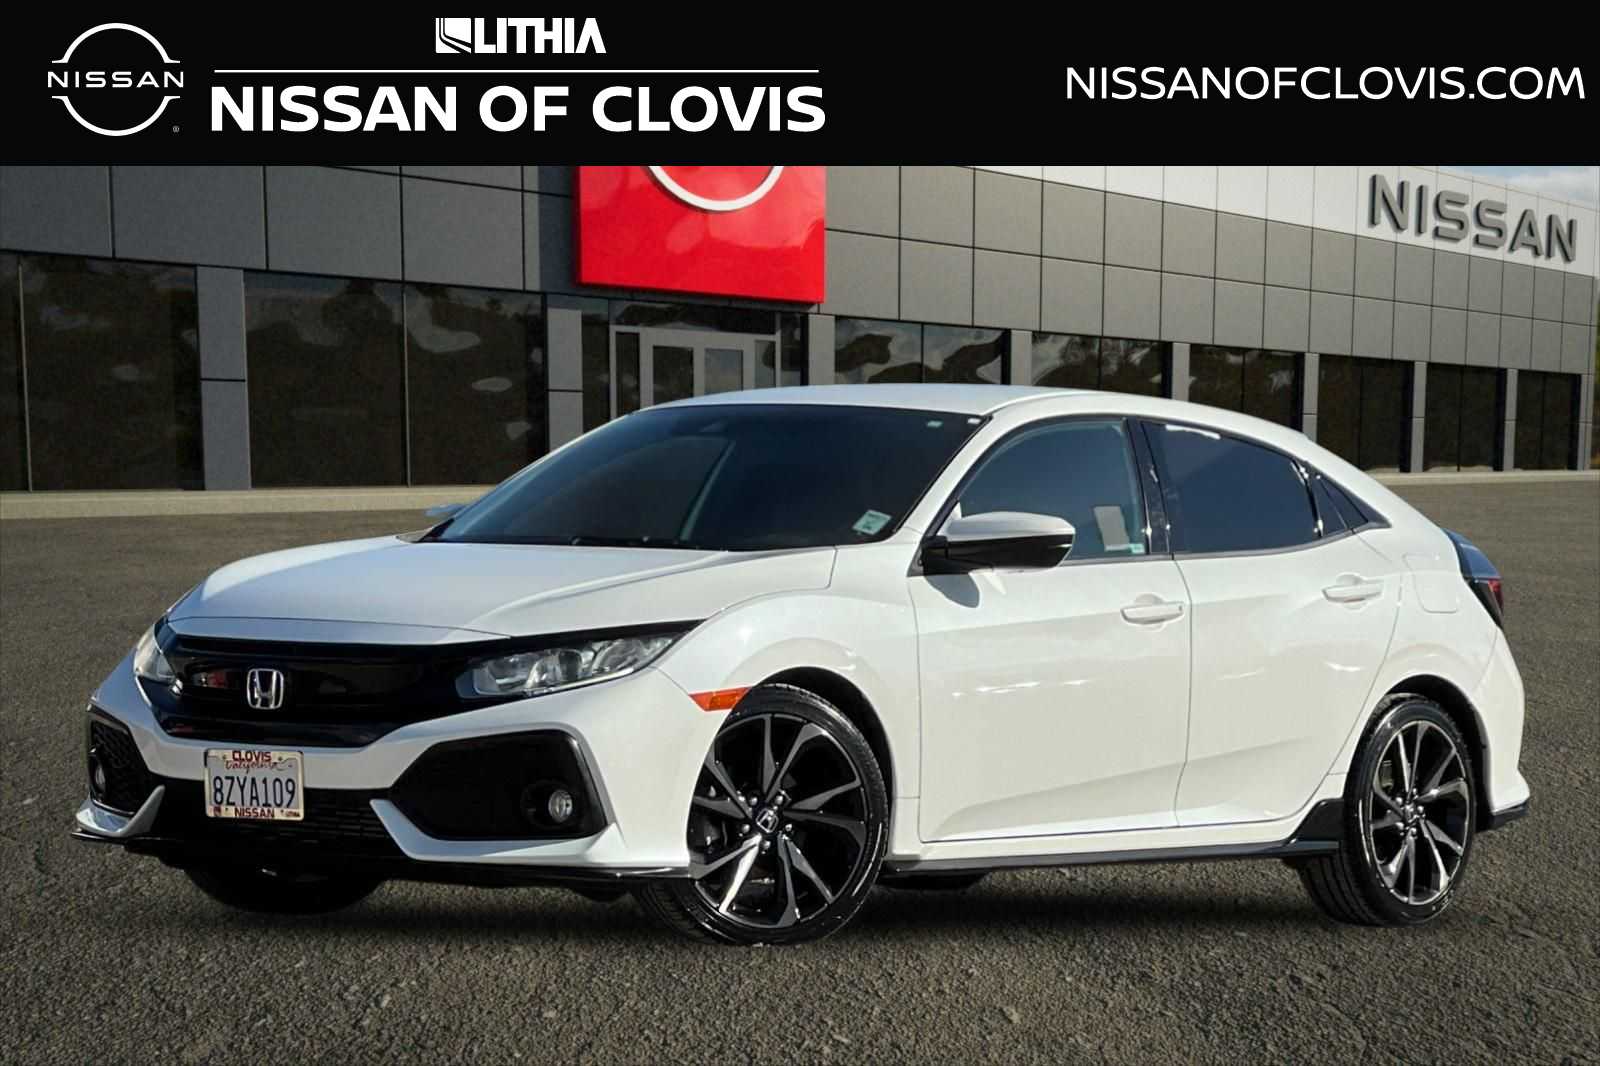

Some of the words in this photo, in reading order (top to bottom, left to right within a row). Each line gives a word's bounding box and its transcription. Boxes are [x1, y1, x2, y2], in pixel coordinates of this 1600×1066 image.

[1368, 174, 1578, 263] NISSAN
[232, 750, 272, 762] CLOVIS
[213, 775, 296, 808] 8ZYA109
[234, 807, 275, 818] NISSAN
